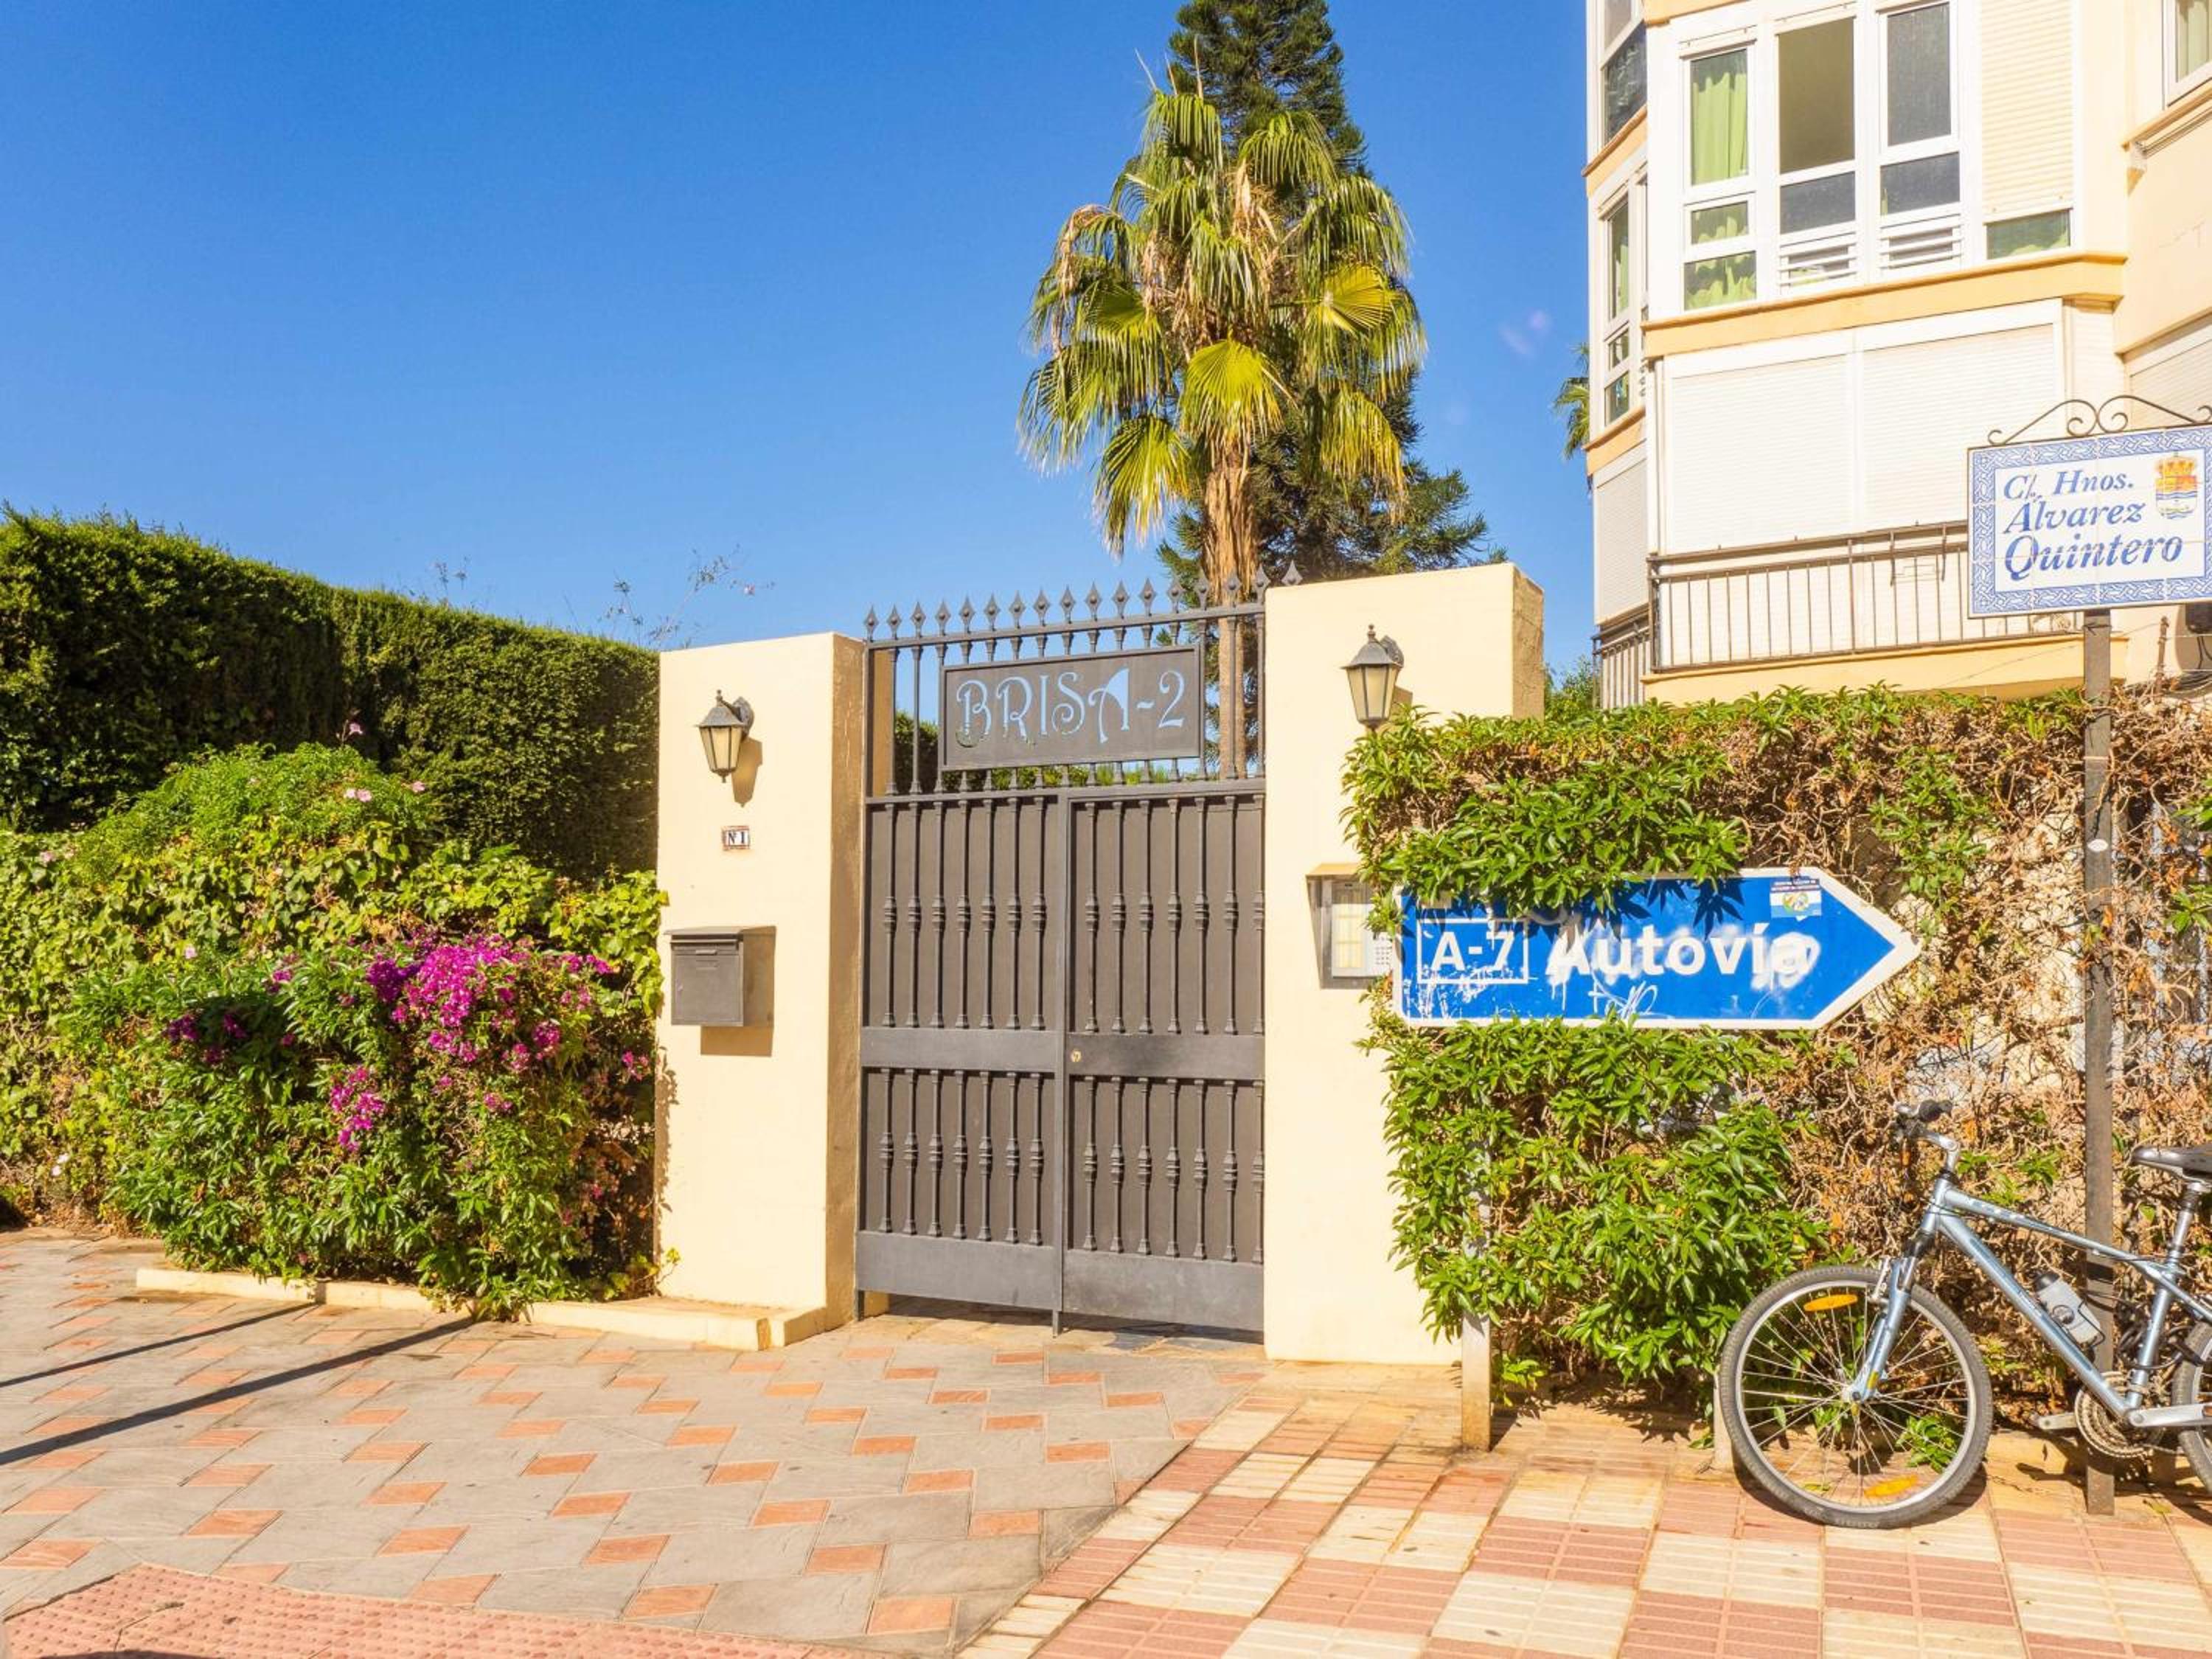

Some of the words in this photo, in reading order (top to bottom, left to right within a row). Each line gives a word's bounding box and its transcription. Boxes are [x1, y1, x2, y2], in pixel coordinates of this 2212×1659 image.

[2053, 470, 2134, 495] Hnos.
[2004, 533, 2183, 581] Quintero
[956, 667, 1184, 744] BRISA-2
[1431, 931, 1515, 971] A-7
